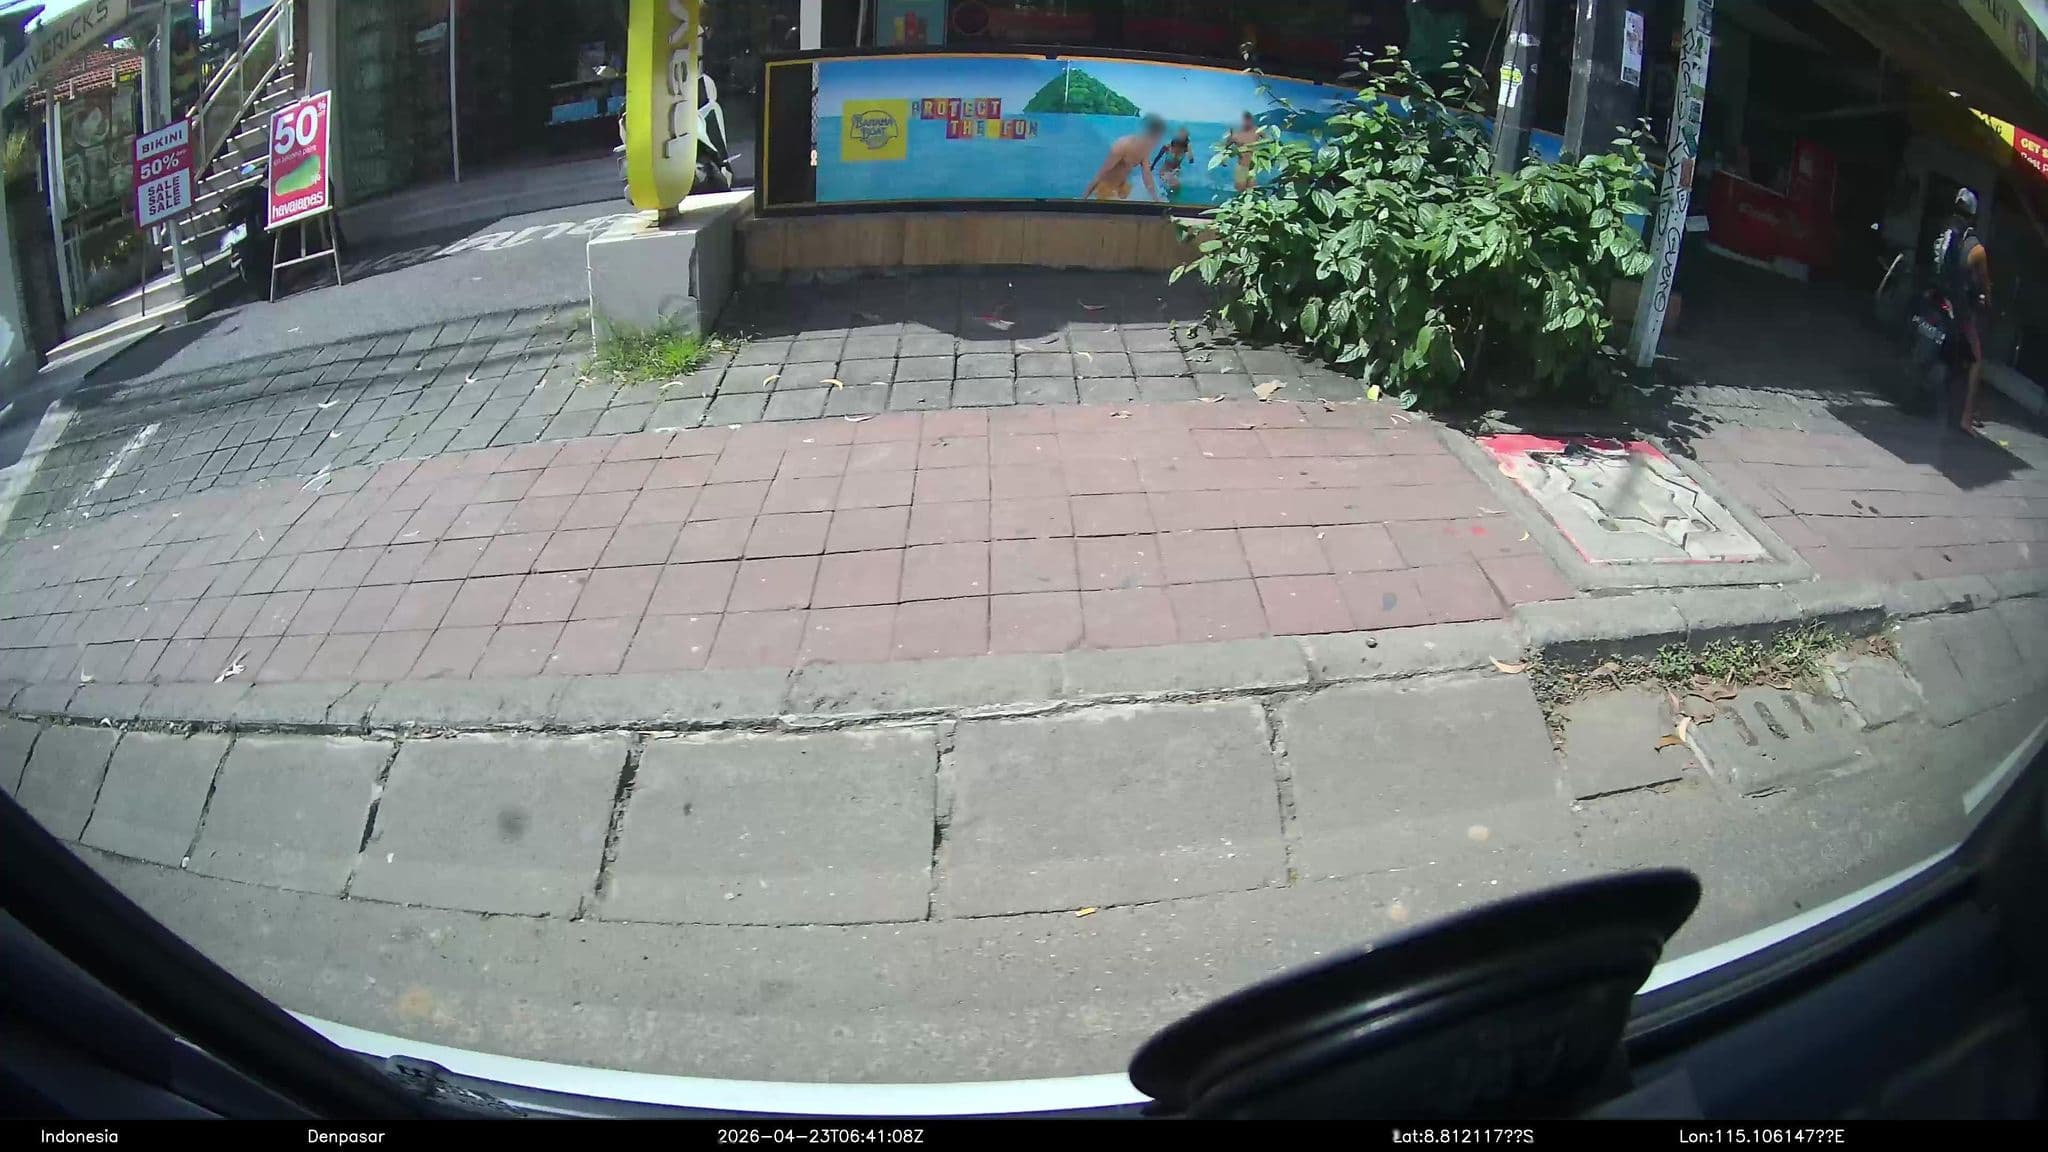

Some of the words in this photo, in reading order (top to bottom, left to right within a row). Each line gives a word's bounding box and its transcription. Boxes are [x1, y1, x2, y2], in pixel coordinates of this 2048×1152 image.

[8, 0, 108, 92] MAVERICKS
[911, 98, 1001, 119] PROTECT
[949, 120, 985, 137] THE
[1001, 120, 1038, 137] FUN
[142, 130, 183, 154] BIKINI
[141, 152, 180, 180] 50%
[148, 176, 180, 197] SALE
[149, 186, 180, 206] SALE
[149, 197, 181, 216] SALE
